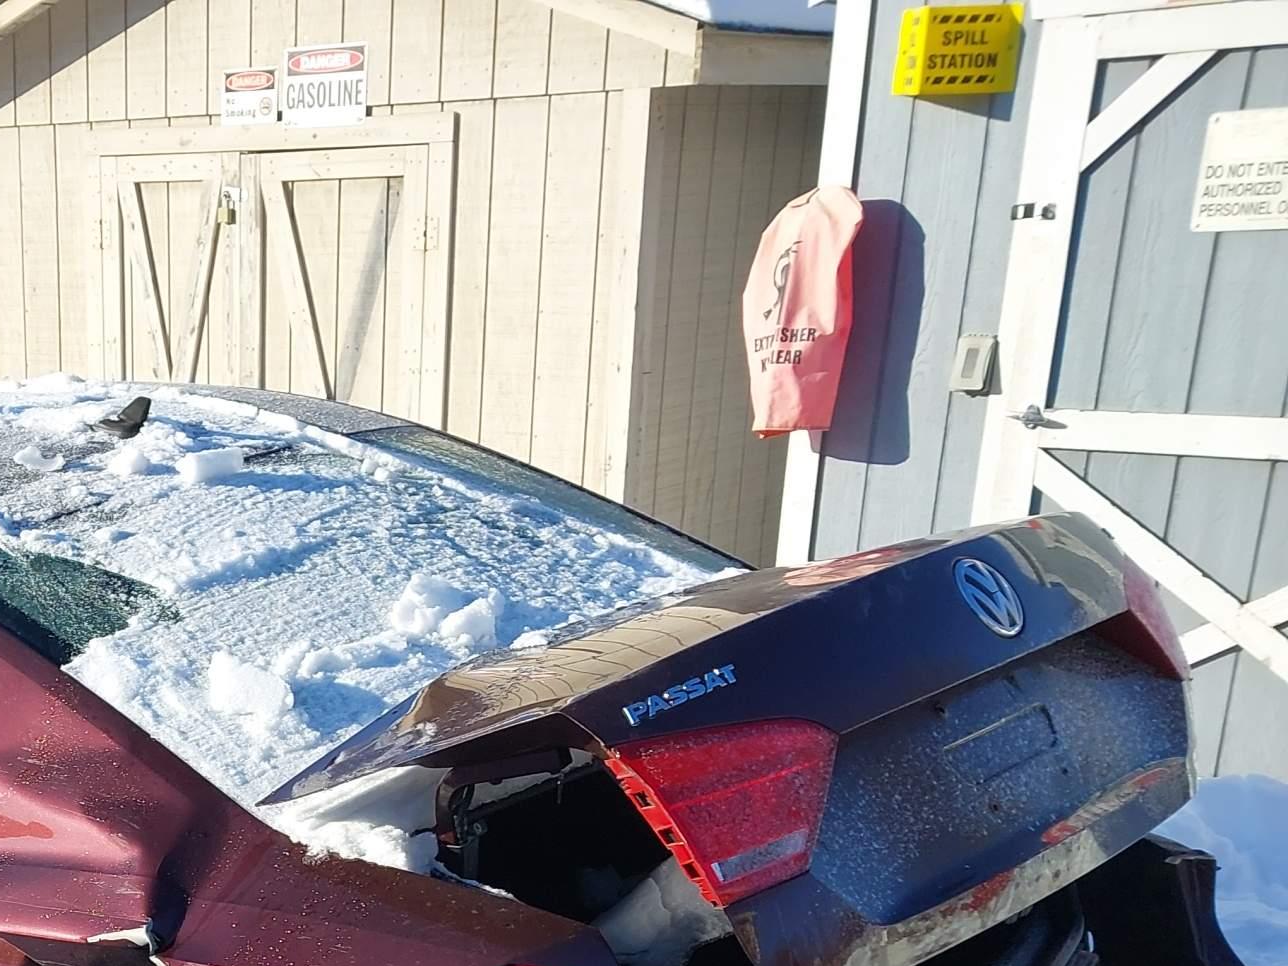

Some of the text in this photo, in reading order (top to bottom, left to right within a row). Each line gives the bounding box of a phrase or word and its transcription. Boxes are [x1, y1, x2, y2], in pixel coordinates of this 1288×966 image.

[942, 29, 989, 46] SPILL
[927, 53, 999, 69] STATION
[286, 79, 364, 110] GASOLINE
[1205, 160, 1288, 180] DO NOT ENTE
[1201, 181, 1282, 198] AUTHORIZED
[1198, 201, 1272, 217] PERSONNEL
[622, 663, 737, 726] PASSAT
